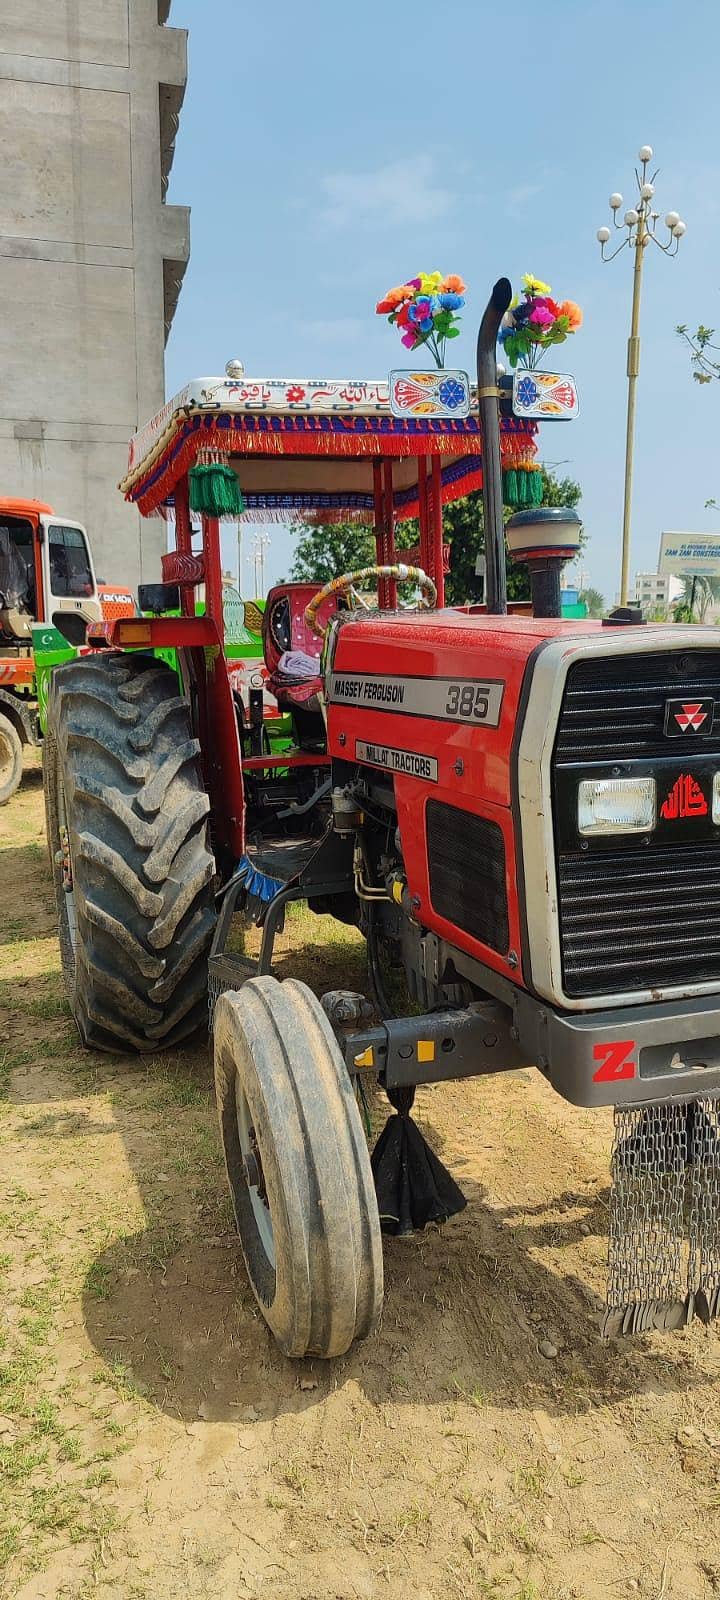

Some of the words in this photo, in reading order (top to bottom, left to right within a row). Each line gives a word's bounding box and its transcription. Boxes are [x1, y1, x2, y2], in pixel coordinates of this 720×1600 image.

[334, 680, 363, 698] MASSEY
[363, 682, 405, 703] FERGUSON
[446, 685, 490, 718] 385
[366, 745, 389, 766] MILLAT
[390, 751, 431, 776] TRACTORS
[592, 1040, 637, 1084] Z
